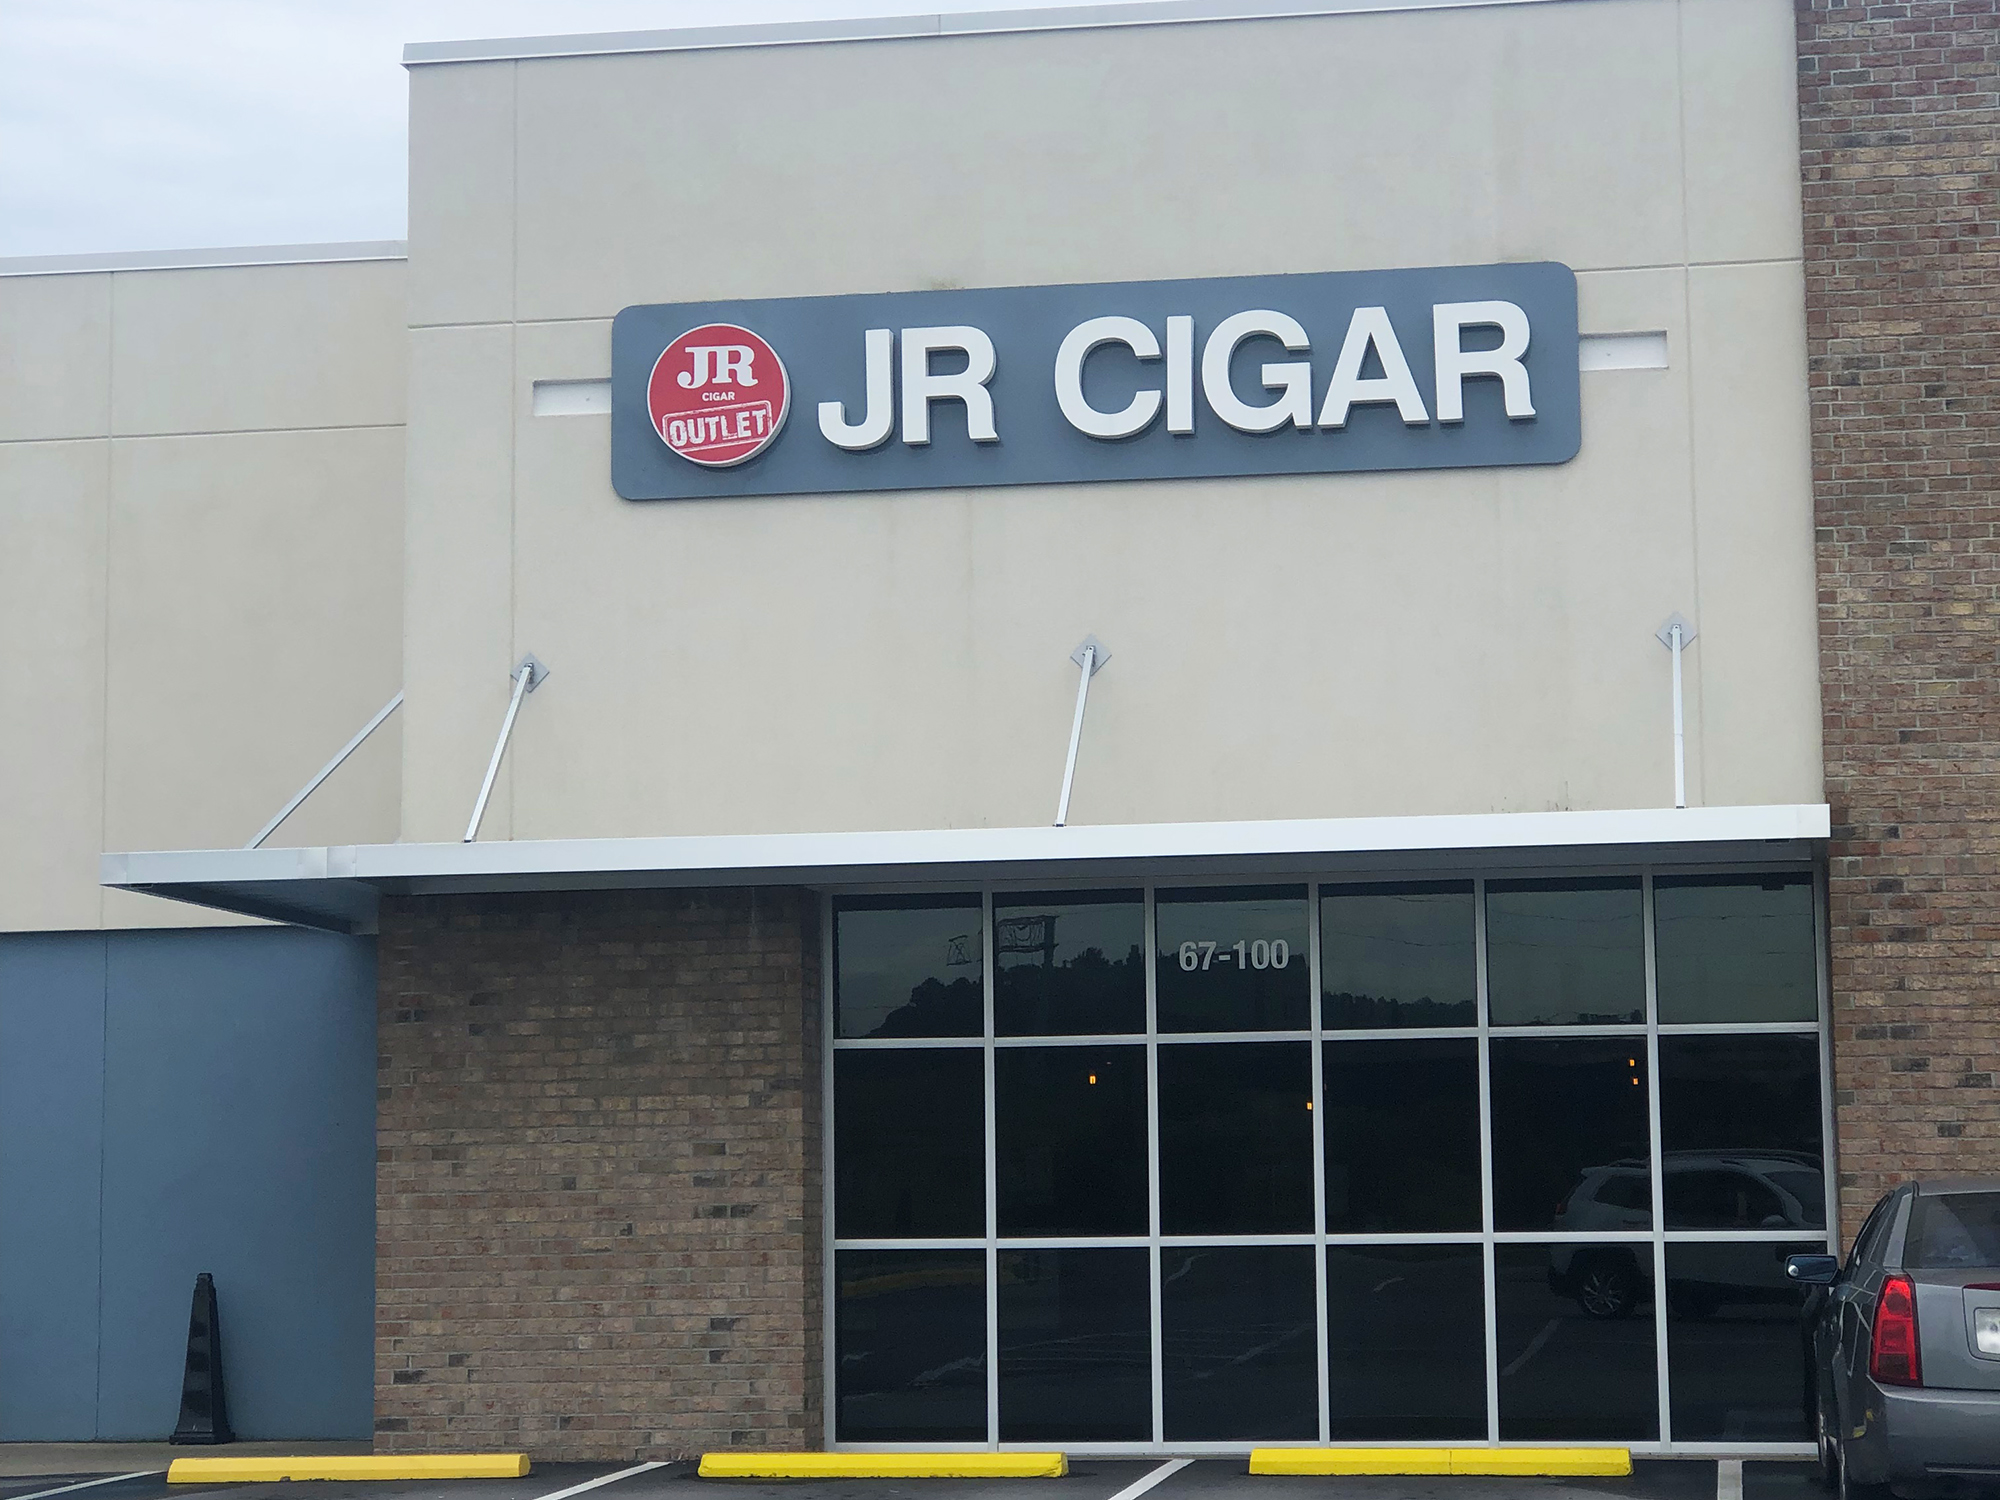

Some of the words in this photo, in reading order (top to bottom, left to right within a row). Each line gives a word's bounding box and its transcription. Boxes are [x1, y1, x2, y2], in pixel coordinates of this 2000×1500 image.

[677, 345, 758, 389] JR
[818, 325, 999, 450] JR
[1054, 300, 1537, 439] CIGAR
[702, 391, 735, 401] CIGAR
[669, 409, 767, 447] OUTLET
[1178, 939, 1289, 971] 67-100
